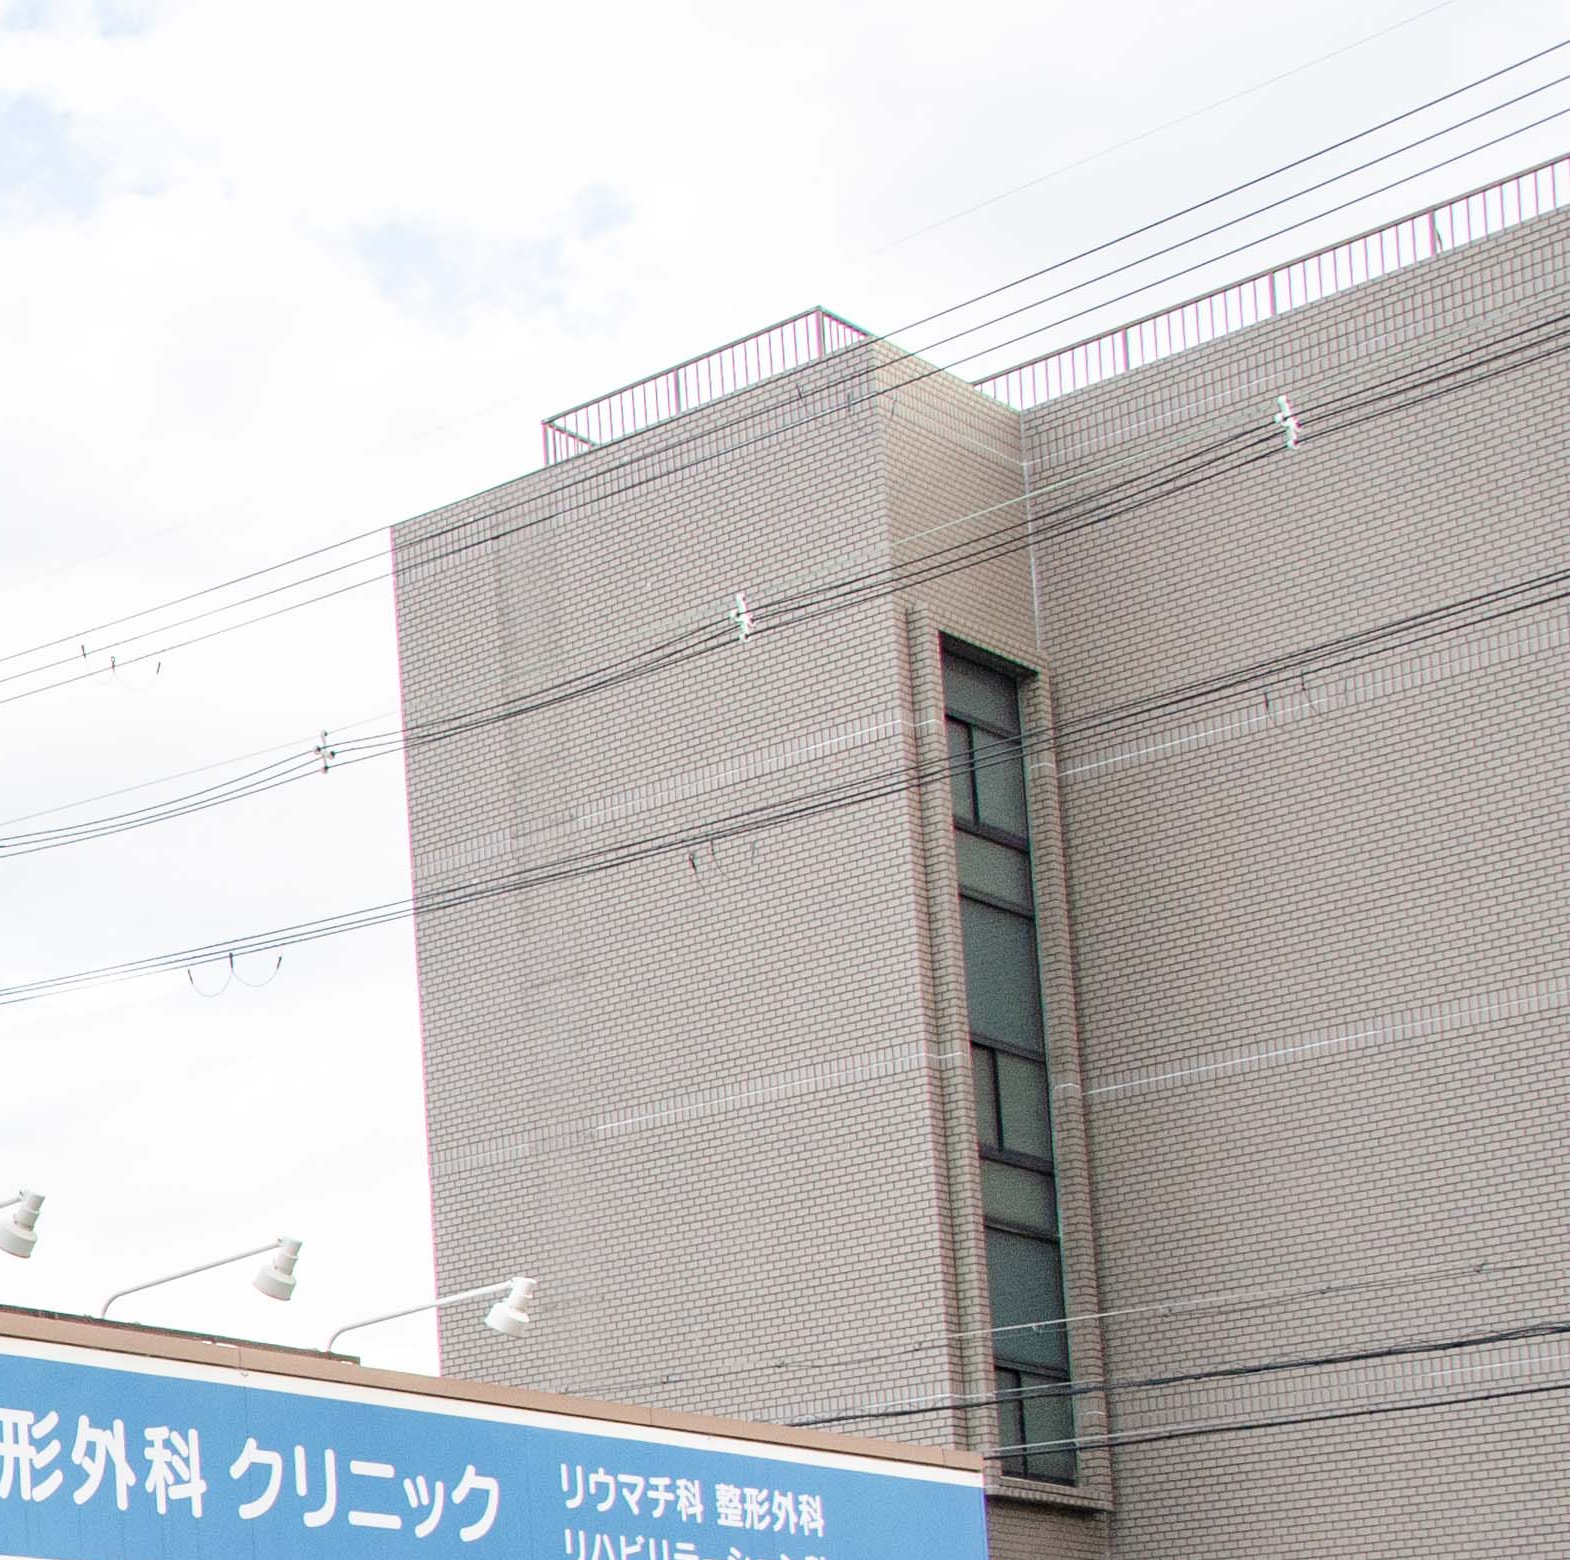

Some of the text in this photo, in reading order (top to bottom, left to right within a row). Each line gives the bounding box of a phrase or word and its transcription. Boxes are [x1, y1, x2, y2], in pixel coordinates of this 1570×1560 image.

[228, 1436, 500, 1543] クリニック
[560, 1463, 825, 1538] リウマチ科 整形外科
